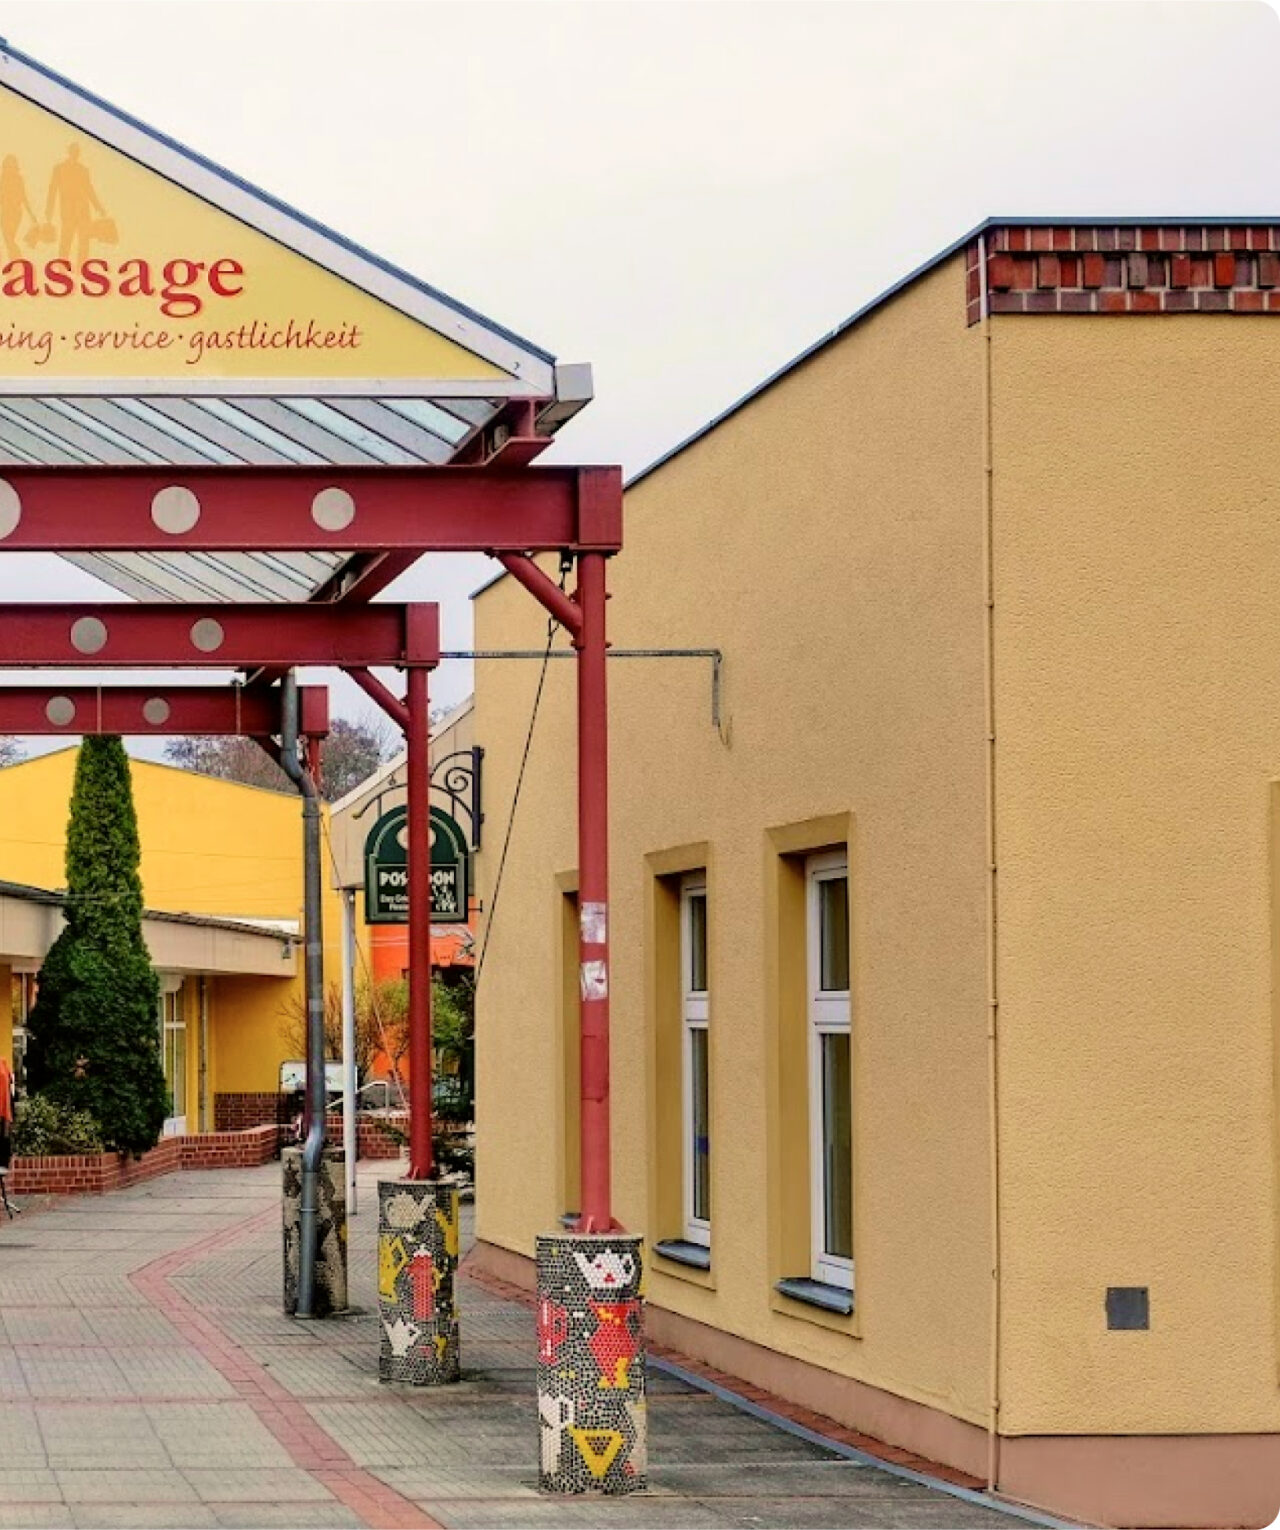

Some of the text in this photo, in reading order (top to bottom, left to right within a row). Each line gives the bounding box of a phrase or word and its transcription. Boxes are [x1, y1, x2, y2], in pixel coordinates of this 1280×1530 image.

[73, 322, 175, 351] service
[188, 319, 362, 365] gastlichkeit
[380, 870, 455, 887] POSON
